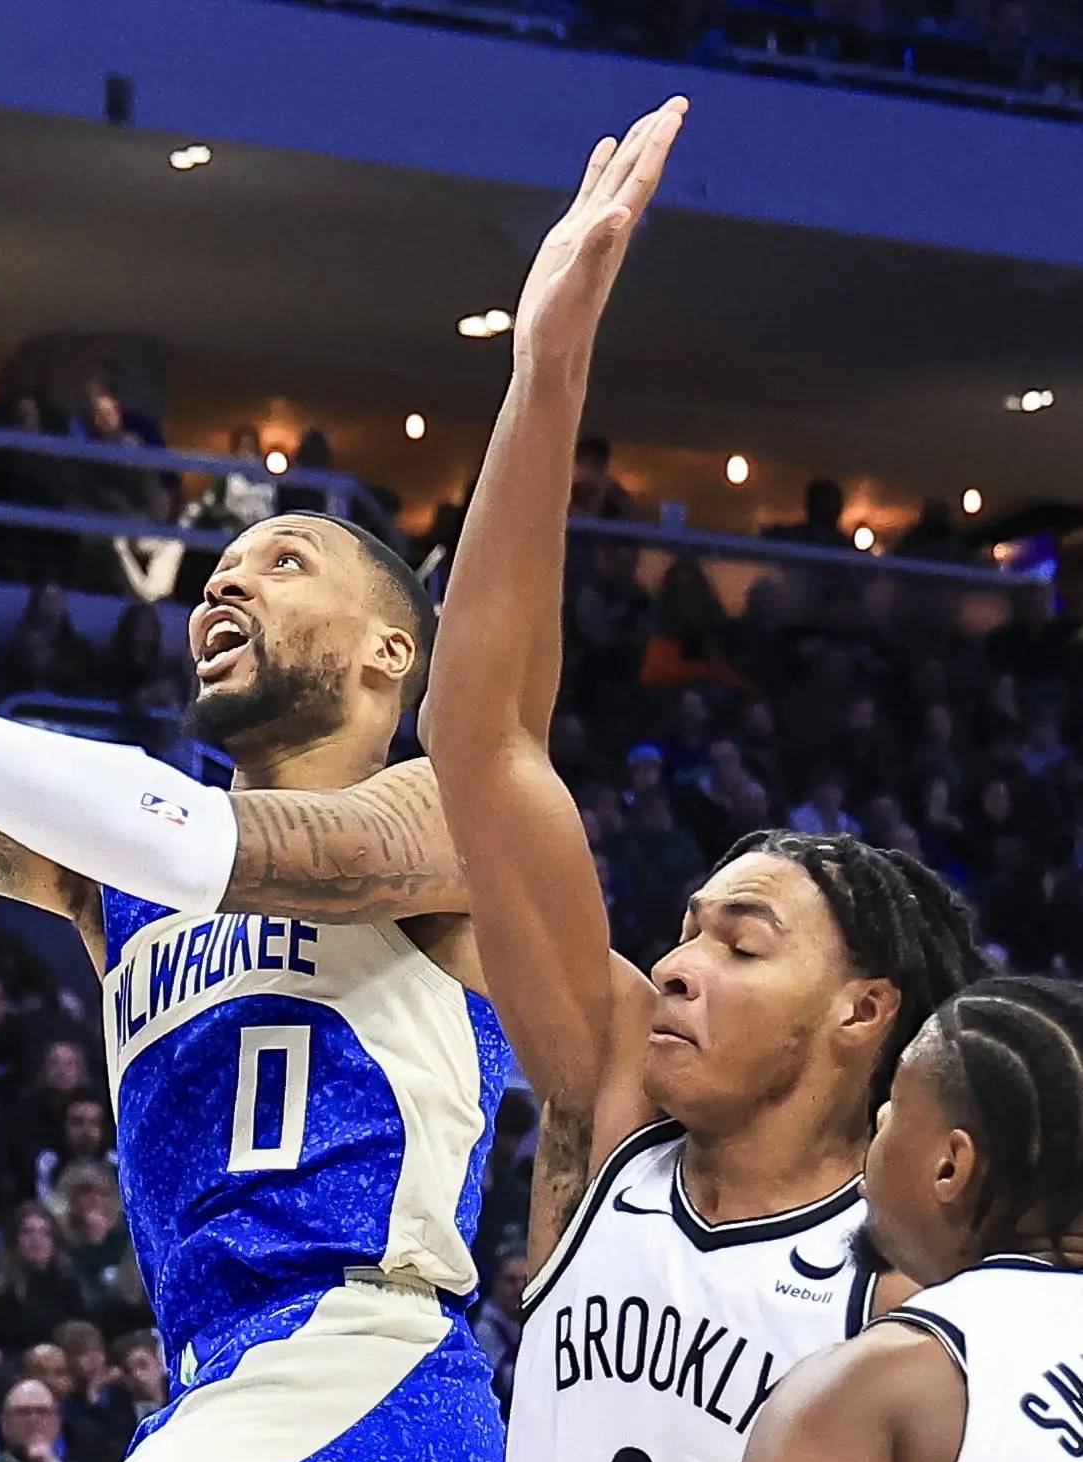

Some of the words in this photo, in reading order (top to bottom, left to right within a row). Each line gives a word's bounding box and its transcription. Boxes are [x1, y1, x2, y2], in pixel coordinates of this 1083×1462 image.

[226, 1024, 311, 1172] 0
[775, 1280, 833, 1304] Webull
[555, 1295, 781, 1434] BROOKLY
